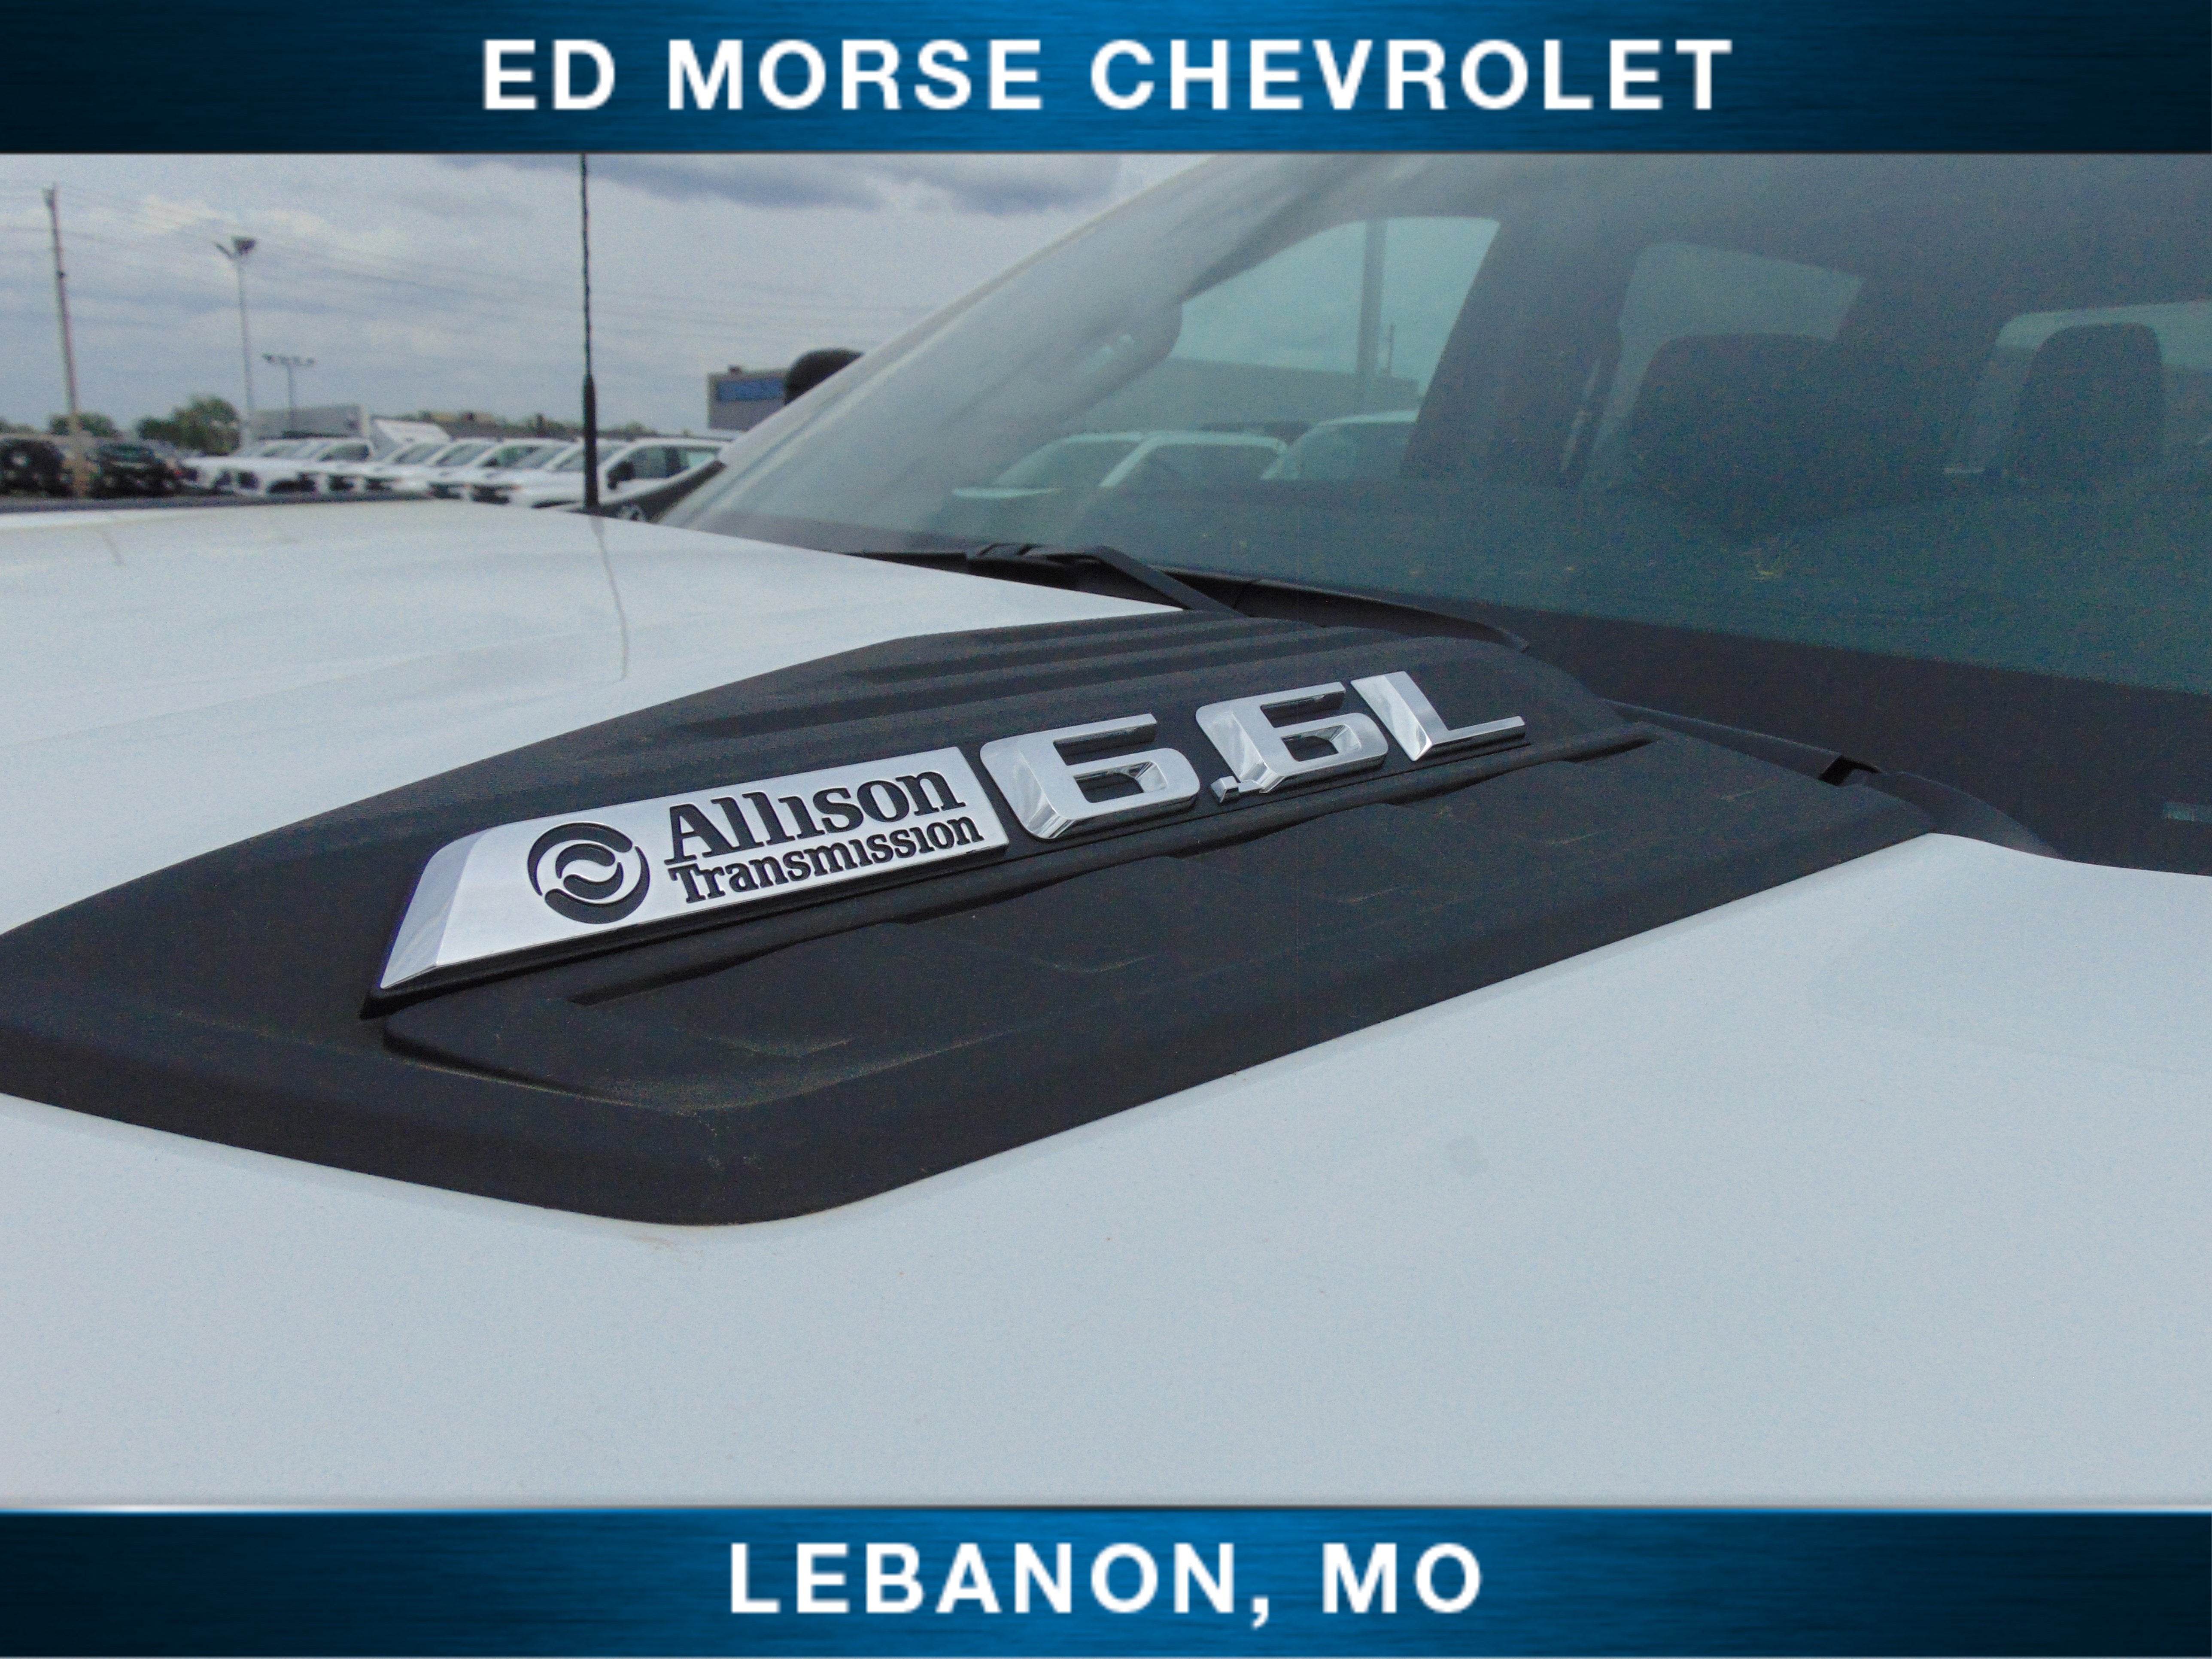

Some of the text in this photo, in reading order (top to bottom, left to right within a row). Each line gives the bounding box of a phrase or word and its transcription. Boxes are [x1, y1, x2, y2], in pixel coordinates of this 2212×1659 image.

[979, 671, 1526, 840] 6.6L
[664, 770, 966, 865] Allison
[667, 815, 985, 904] Transmission
